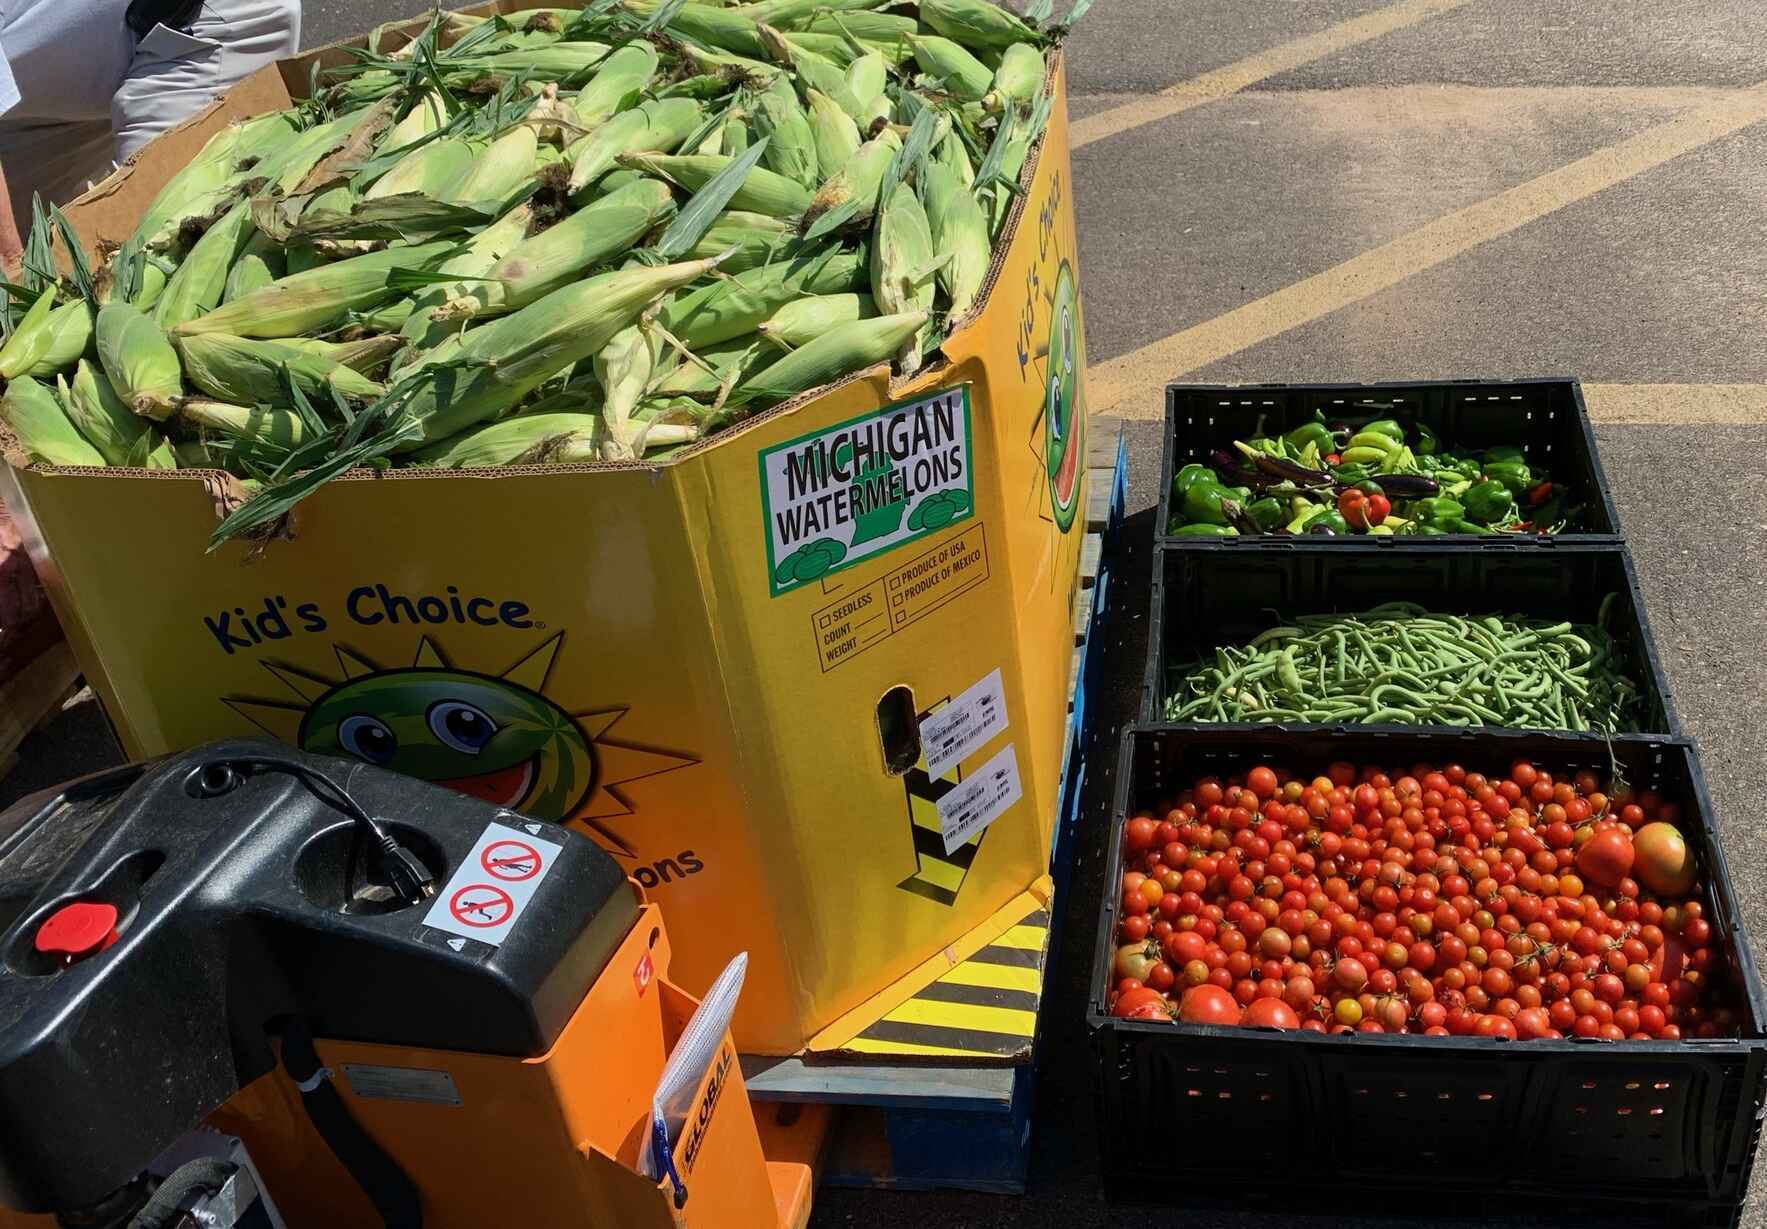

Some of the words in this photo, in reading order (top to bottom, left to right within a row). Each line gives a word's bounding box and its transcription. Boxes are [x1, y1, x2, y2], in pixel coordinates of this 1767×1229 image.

[786, 396, 955, 501] MICHIGAN
[776, 445, 963, 546] WATERMELONS
[902, 556, 937, 585] PRODUCE
[939, 550, 949, 564] OF
[950, 541, 966, 557] USA
[904, 573, 940, 601] PRODUCE
[941, 567, 951, 580] OF
[952, 550, 981, 574] MEXICO
[204, 596, 327, 655] Kid's
[346, 583, 534, 629] Choice
[832, 593, 873, 622] SEEDLESS
[824, 622, 851, 646] COUNT
[826, 637, 857, 662] WEIGHT
[633, 850, 704, 888] ons
[685, 1046, 732, 1164] GLOBAL
